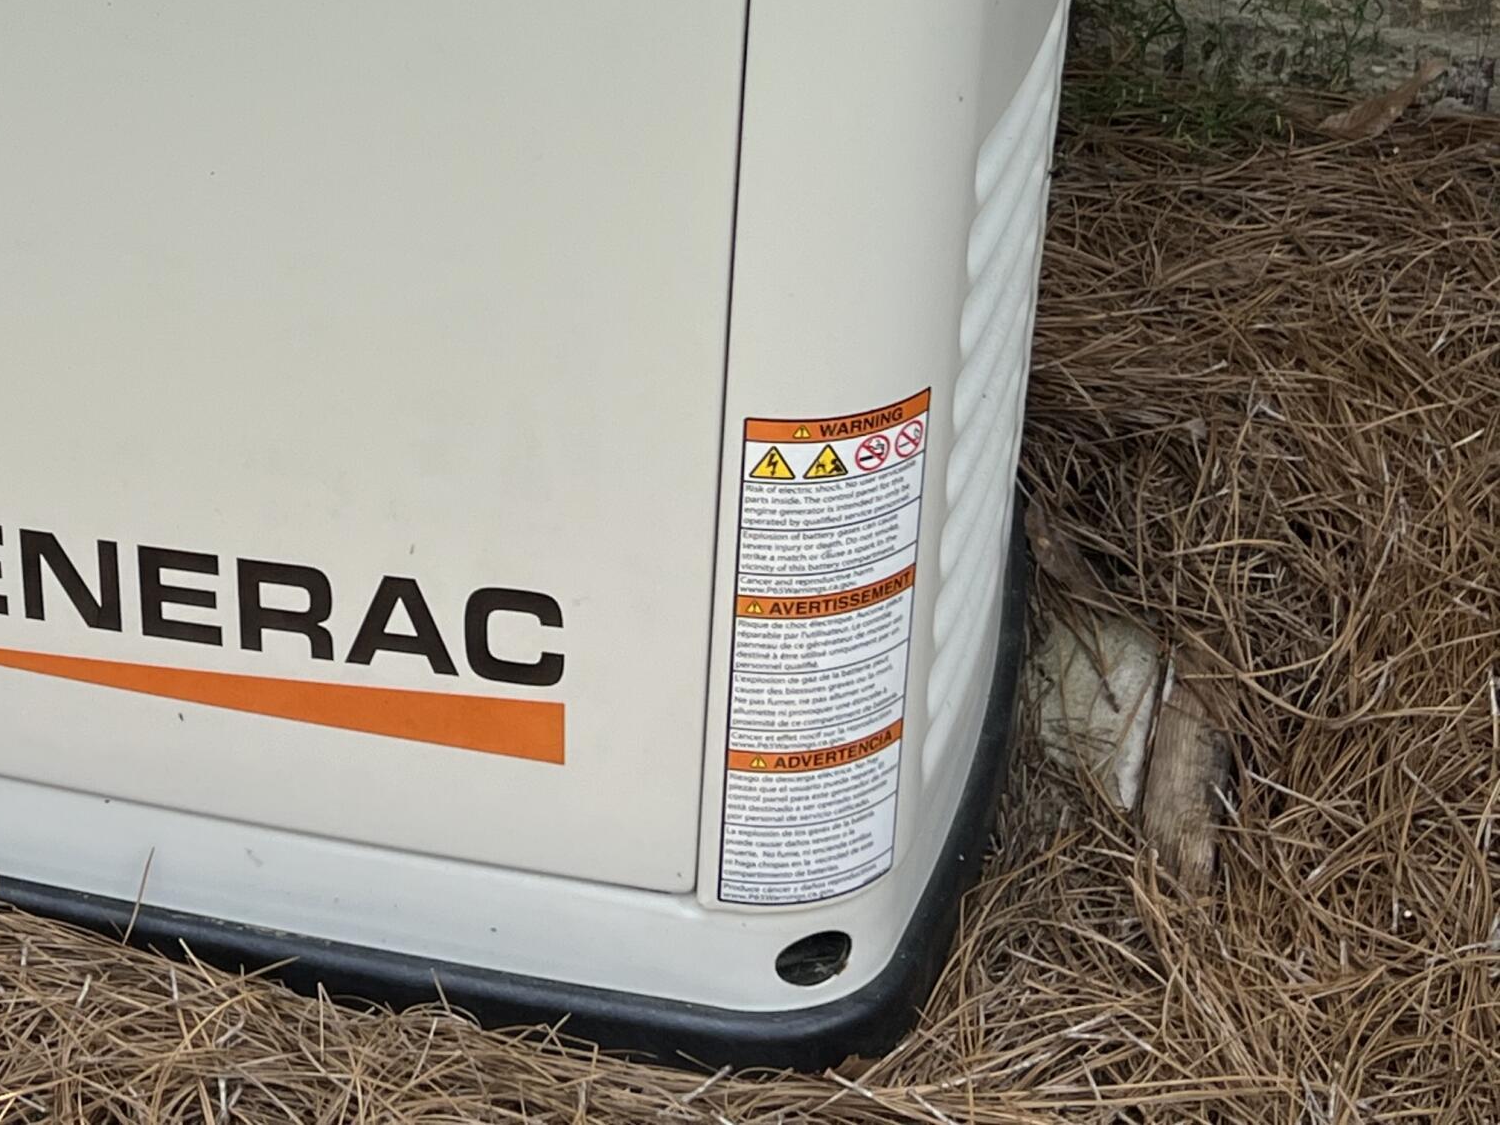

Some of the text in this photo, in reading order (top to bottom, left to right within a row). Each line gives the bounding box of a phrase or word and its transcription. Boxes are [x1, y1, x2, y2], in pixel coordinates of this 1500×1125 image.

[819, 407, 904, 437] WARNING
[769, 572, 911, 615] AVERTISSEMENT
[773, 729, 893, 769] ADVERTENCIA
